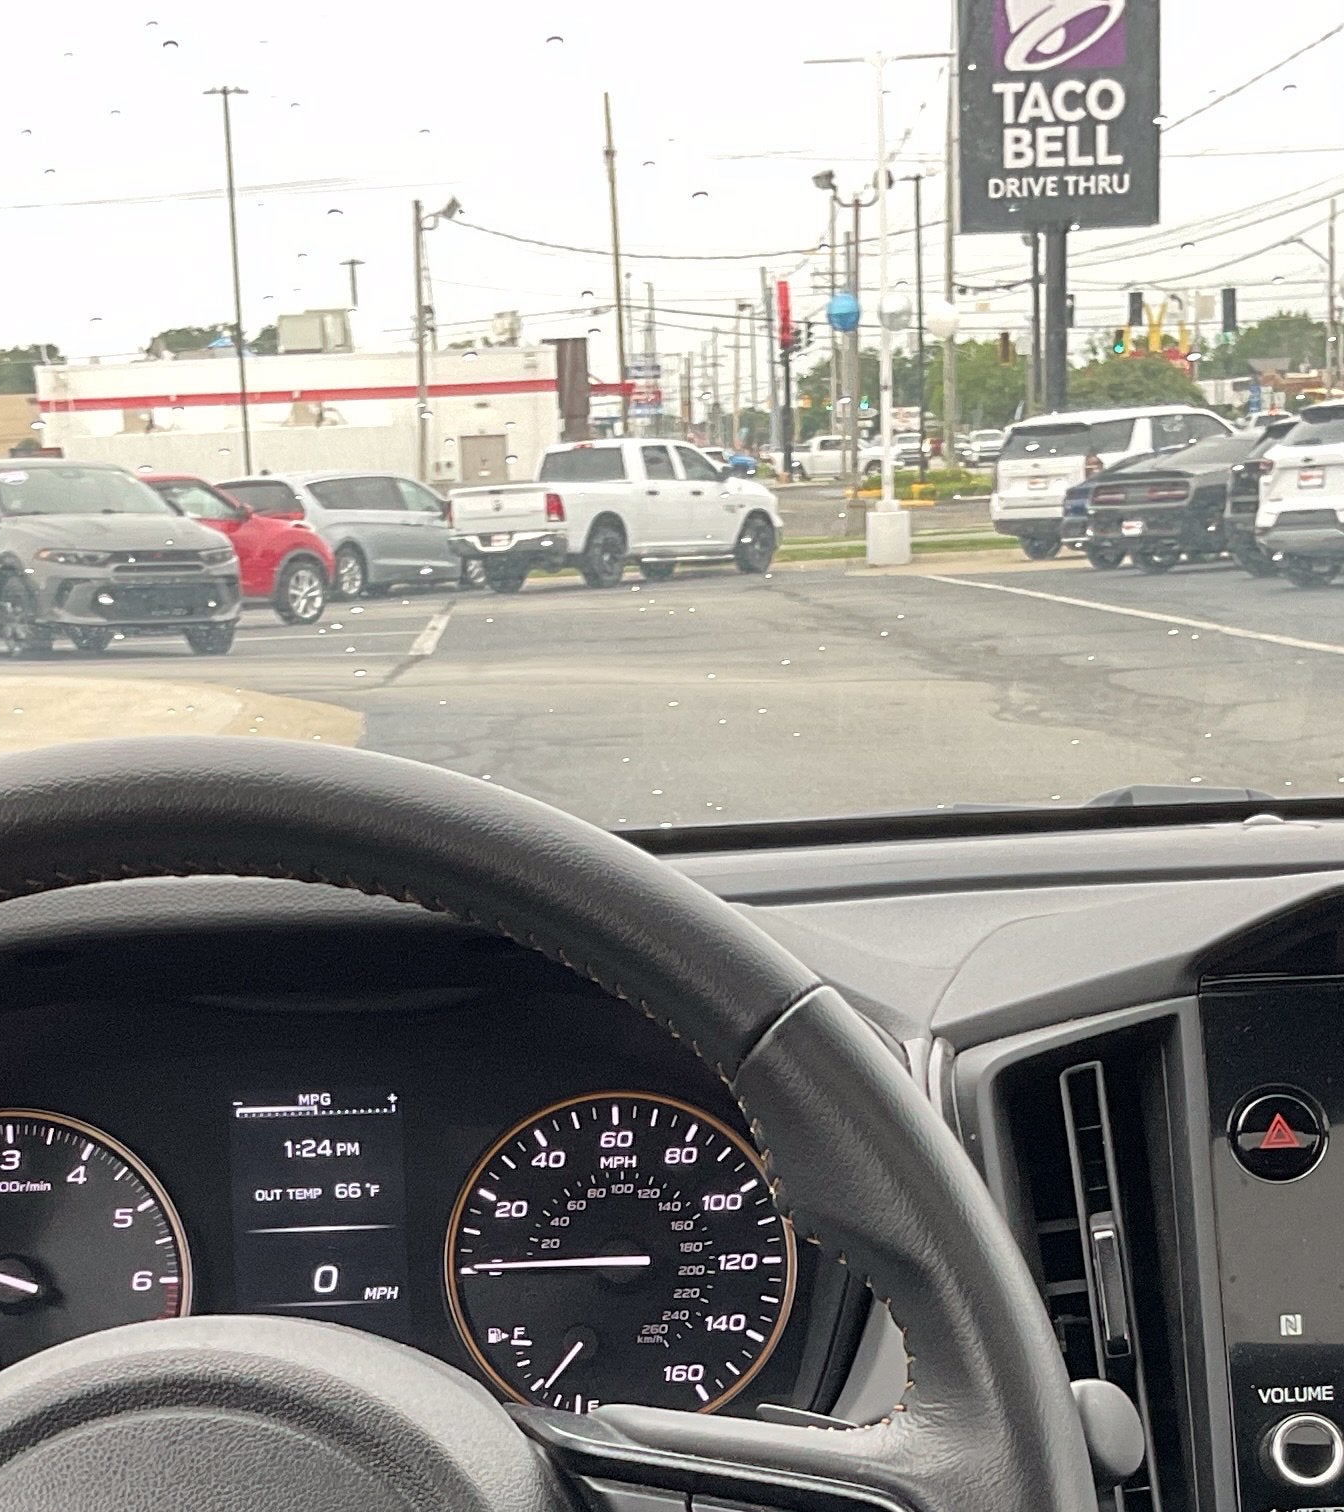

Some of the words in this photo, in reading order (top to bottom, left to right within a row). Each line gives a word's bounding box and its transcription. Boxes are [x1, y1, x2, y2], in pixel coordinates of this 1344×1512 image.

[992, 78, 1126, 124] TACO
[1002, 124, 1123, 169] BELL
[987, 176, 1058, 199] DRIVE
[1064, 174, 1131, 195] THRU
[298, 1093, 332, 1106] MPG
[283, 1139, 333, 1159] 1:24
[336, 1142, 360, 1156] PM
[599, 1131, 634, 1149] 60
[0, 1150, 22, 1171] 3
[530, 1151, 566, 1169] 40
[599, 1155, 637, 1170] MPH
[664, 1147, 698, 1165] 80
[66, 1165, 87, 1185] 4
[254, 1189, 282, 1202] OUT
[286, 1187, 323, 1200] TEMP
[334, 1182, 362, 1199] 66
[586, 1187, 607, 1199] 80
[610, 1183, 634, 1195] 100
[636, 1188, 661, 1199] 120
[494, 1200, 529, 1219] 20
[566, 1200, 587, 1211] 60
[657, 1201, 682, 1212] 140
[701, 1193, 743, 1211] 100
[112, 1207, 134, 1229] 5
[549, 1216, 570, 1228] 40
[670, 1220, 694, 1232] 160
[540, 1238, 561, 1249] 20
[679, 1241, 703, 1253] 180
[677, 1264, 706, 1276] 200
[717, 1253, 758, 1271] 120
[131, 1270, 154, 1291] 6
[313, 1264, 339, 1293] 0
[364, 1285, 399, 1301] MPH
[672, 1288, 701, 1300] 220
[661, 1309, 690, 1321] 240
[704, 1314, 747, 1332] 140
[512, 1326, 526, 1340] F
[641, 1323, 669, 1335] 260
[636, 1333, 663, 1345] km/h
[663, 1364, 705, 1383] 160
[1258, 1385, 1335, 1404] VOLUME
[587, 1399, 600, 1413] E
